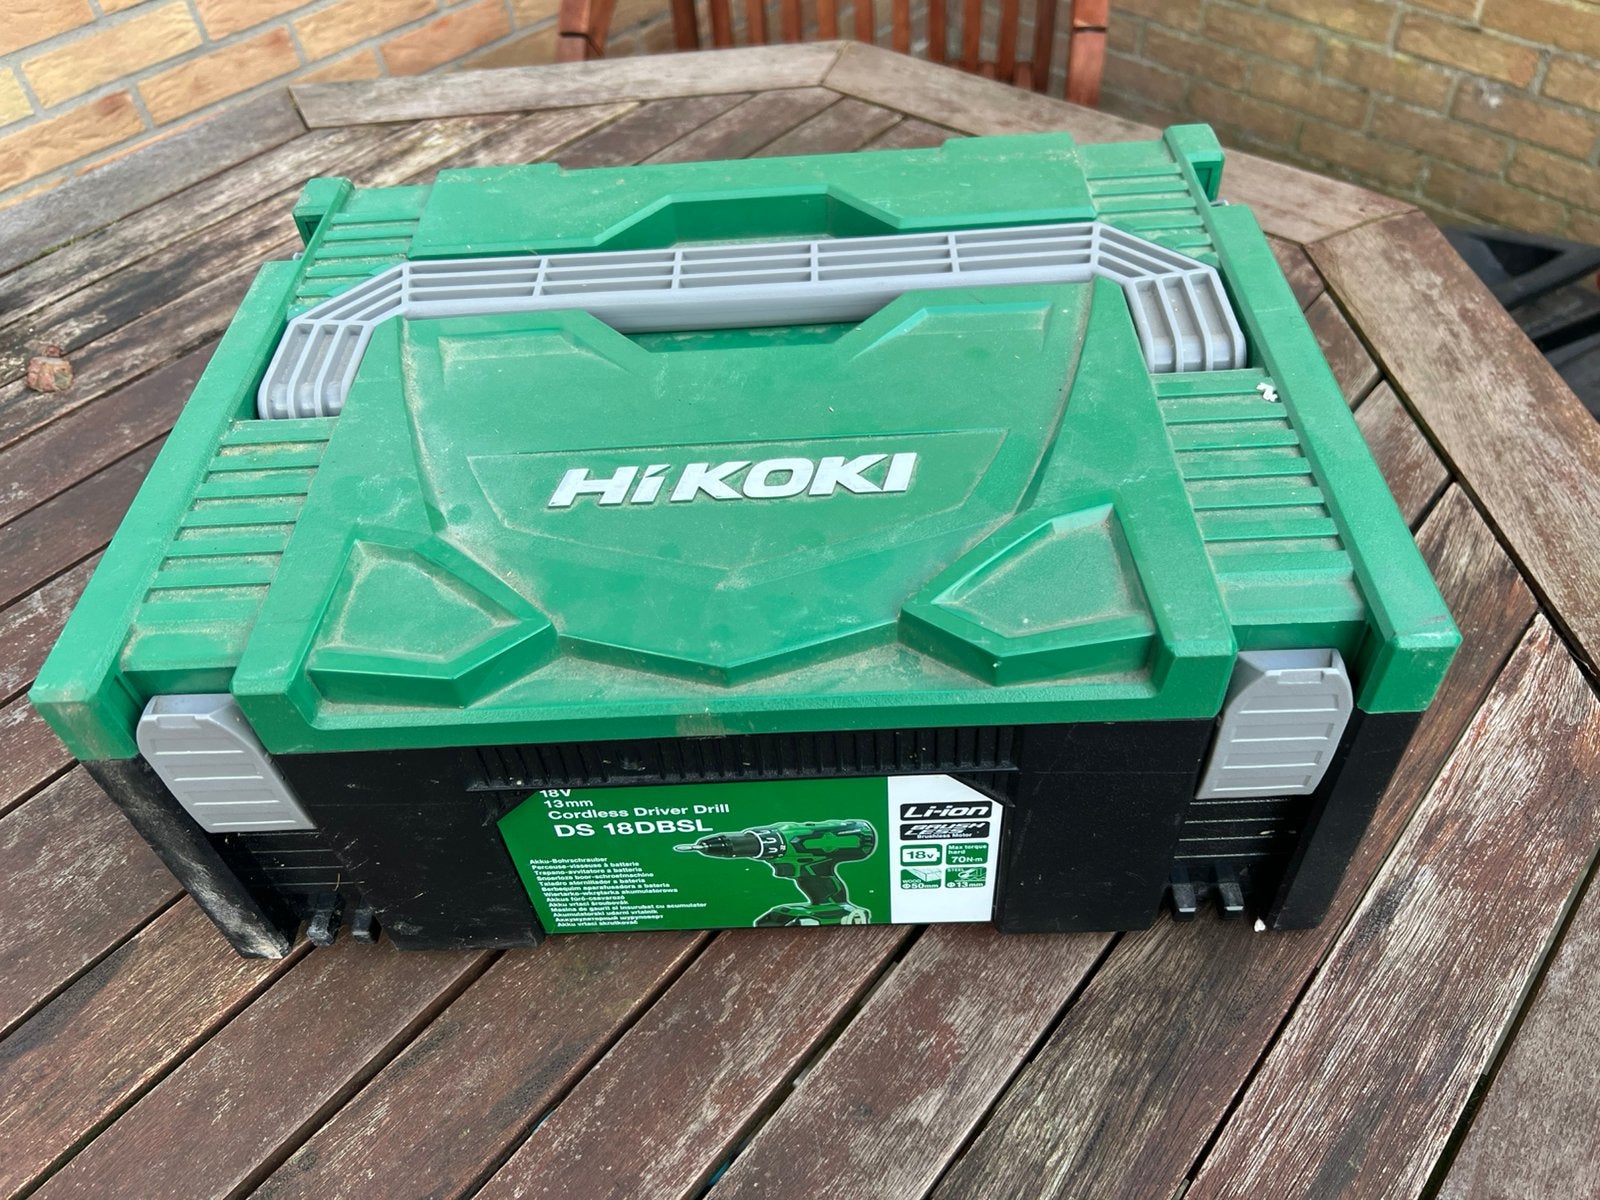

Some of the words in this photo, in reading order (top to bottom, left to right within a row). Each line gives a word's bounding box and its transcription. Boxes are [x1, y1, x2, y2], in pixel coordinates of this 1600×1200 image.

[548, 452, 917, 508] HiKOKI
[540, 789, 571, 798] 18V
[544, 800, 594, 808] 13mm
[548, 809, 629, 820] Cordless
[634, 807, 688, 817] Driver
[694, 804, 730, 814] Drill
[903, 805, 989, 818] Li-ion
[554, 823, 595, 837] DS
[603, 819, 713, 835] 18DBSL
[530, 857, 608, 865] Akku-Bohrschrauber
[534, 868, 606, 876] Trapano-avvitatore
